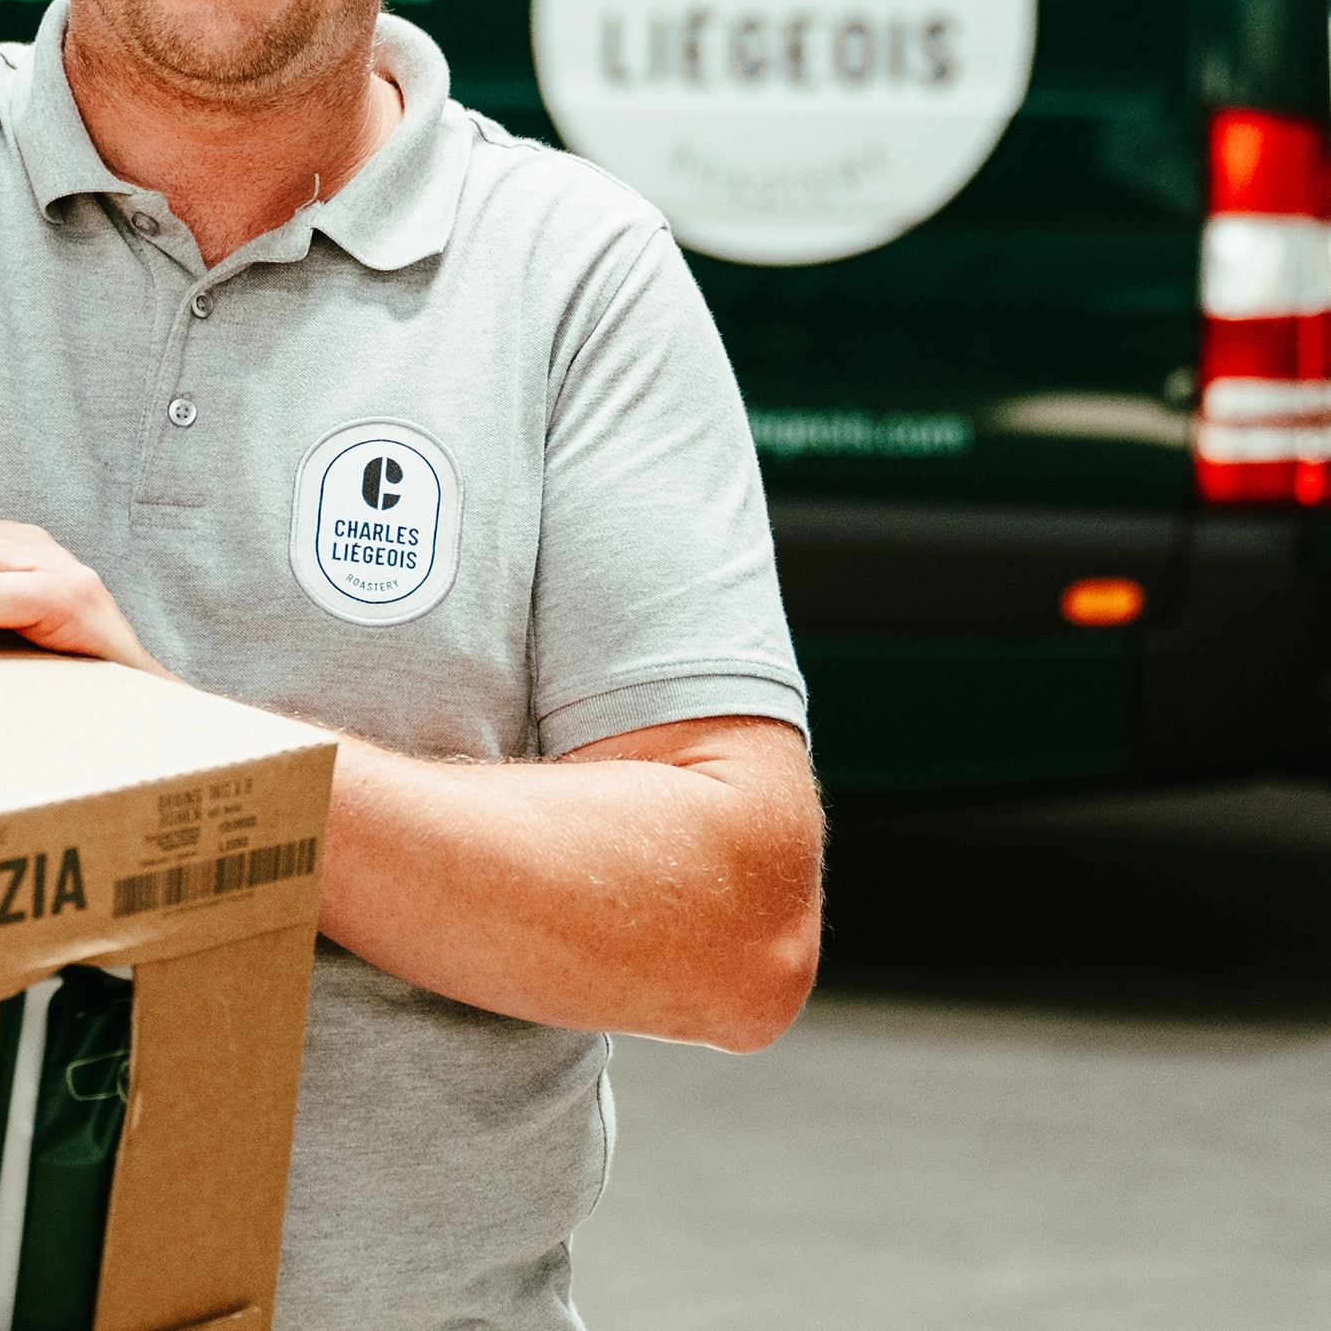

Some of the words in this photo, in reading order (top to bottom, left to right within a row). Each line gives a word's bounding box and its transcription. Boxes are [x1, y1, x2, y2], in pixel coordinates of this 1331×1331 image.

[334, 519, 419, 547] CHARLES
[331, 541, 417, 570] LIÉGEOIS
[345, 573, 400, 592] ROASTERY
